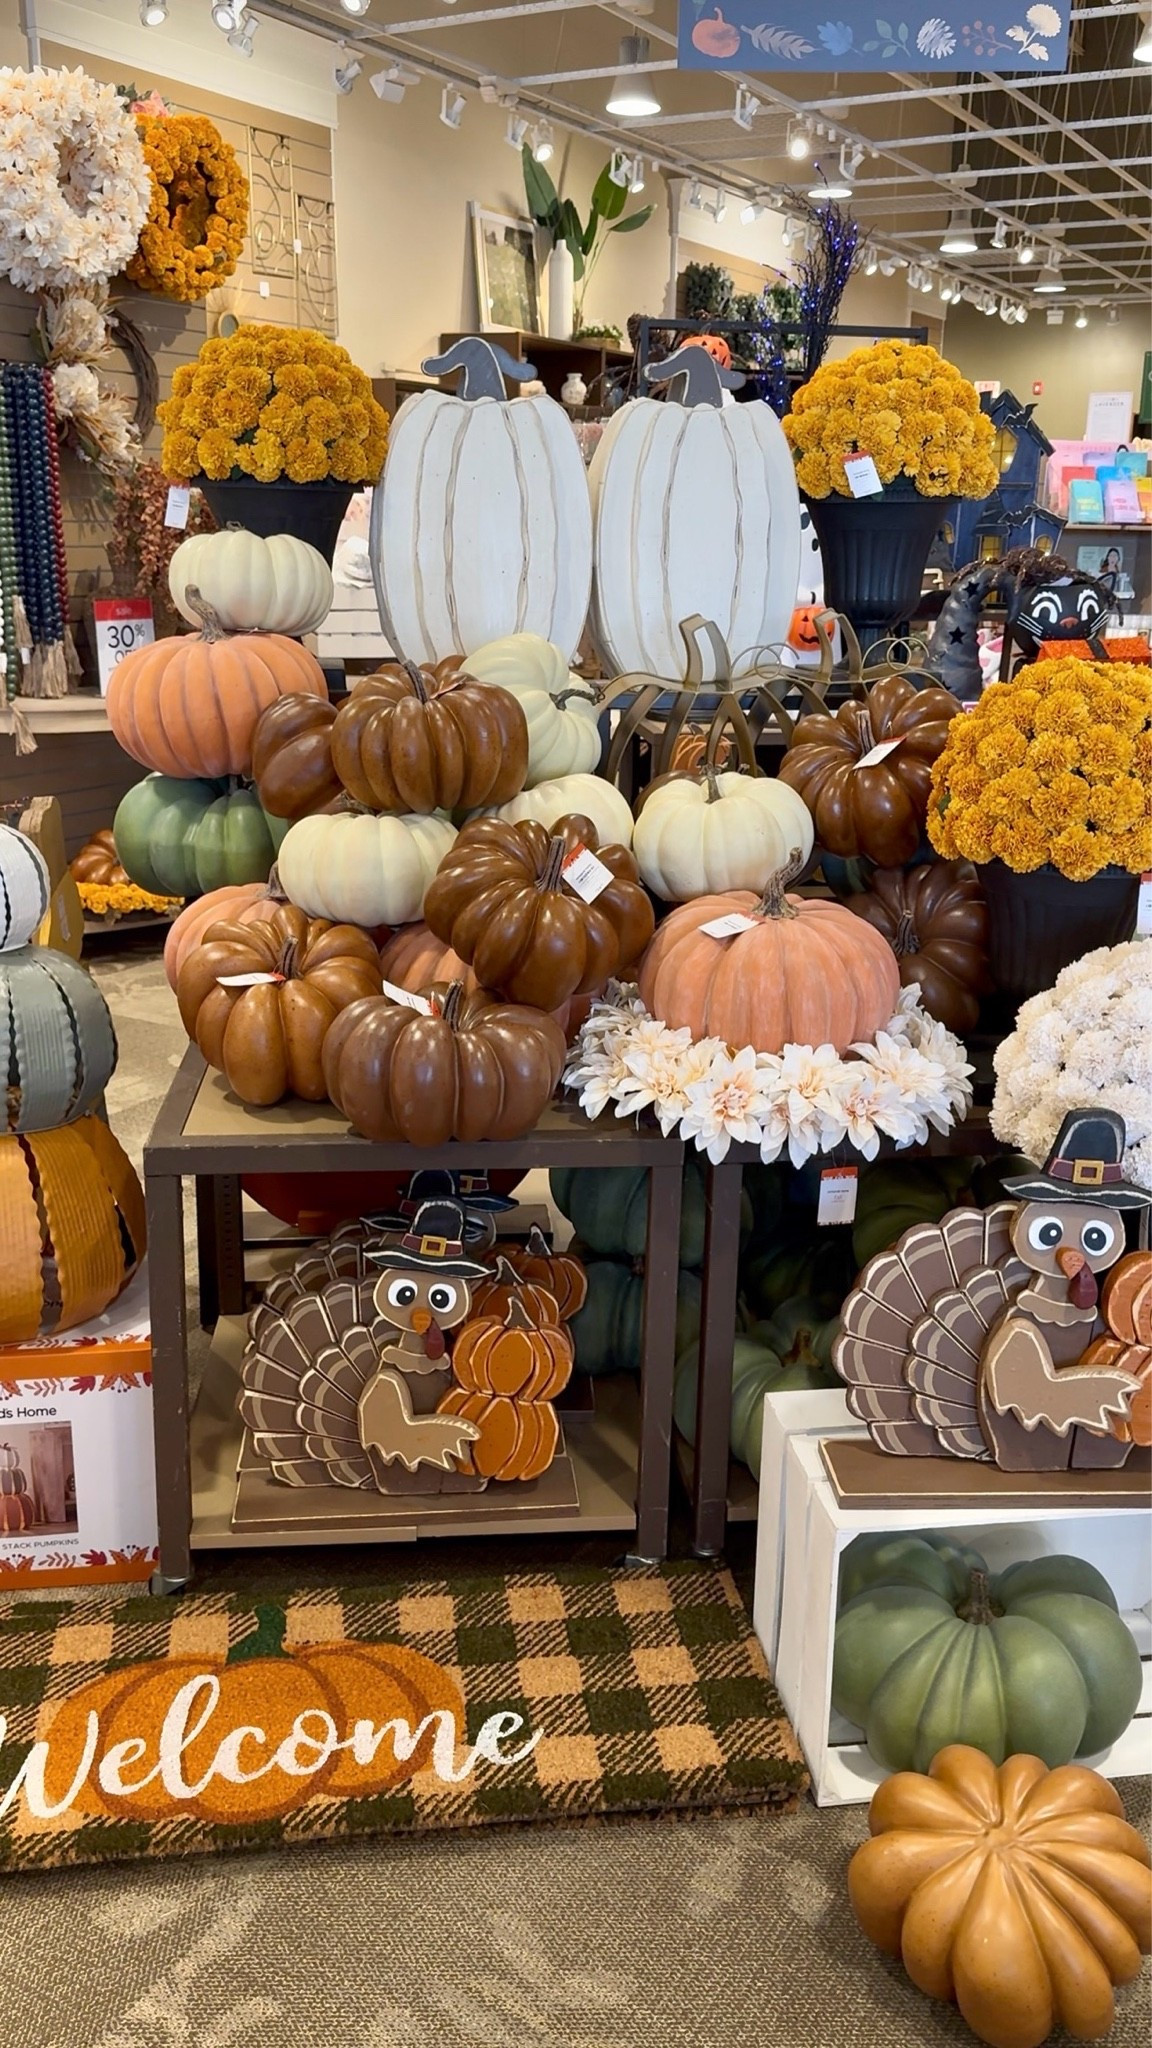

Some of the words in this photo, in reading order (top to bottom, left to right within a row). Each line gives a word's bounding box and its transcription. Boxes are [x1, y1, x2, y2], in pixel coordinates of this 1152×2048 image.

[106, 624, 146, 649] 30%
[17, 1407, 57, 1418] Home
[2, 1542, 31, 1550] STACK
[34, 1538, 79, 1548] PUMPKINS
